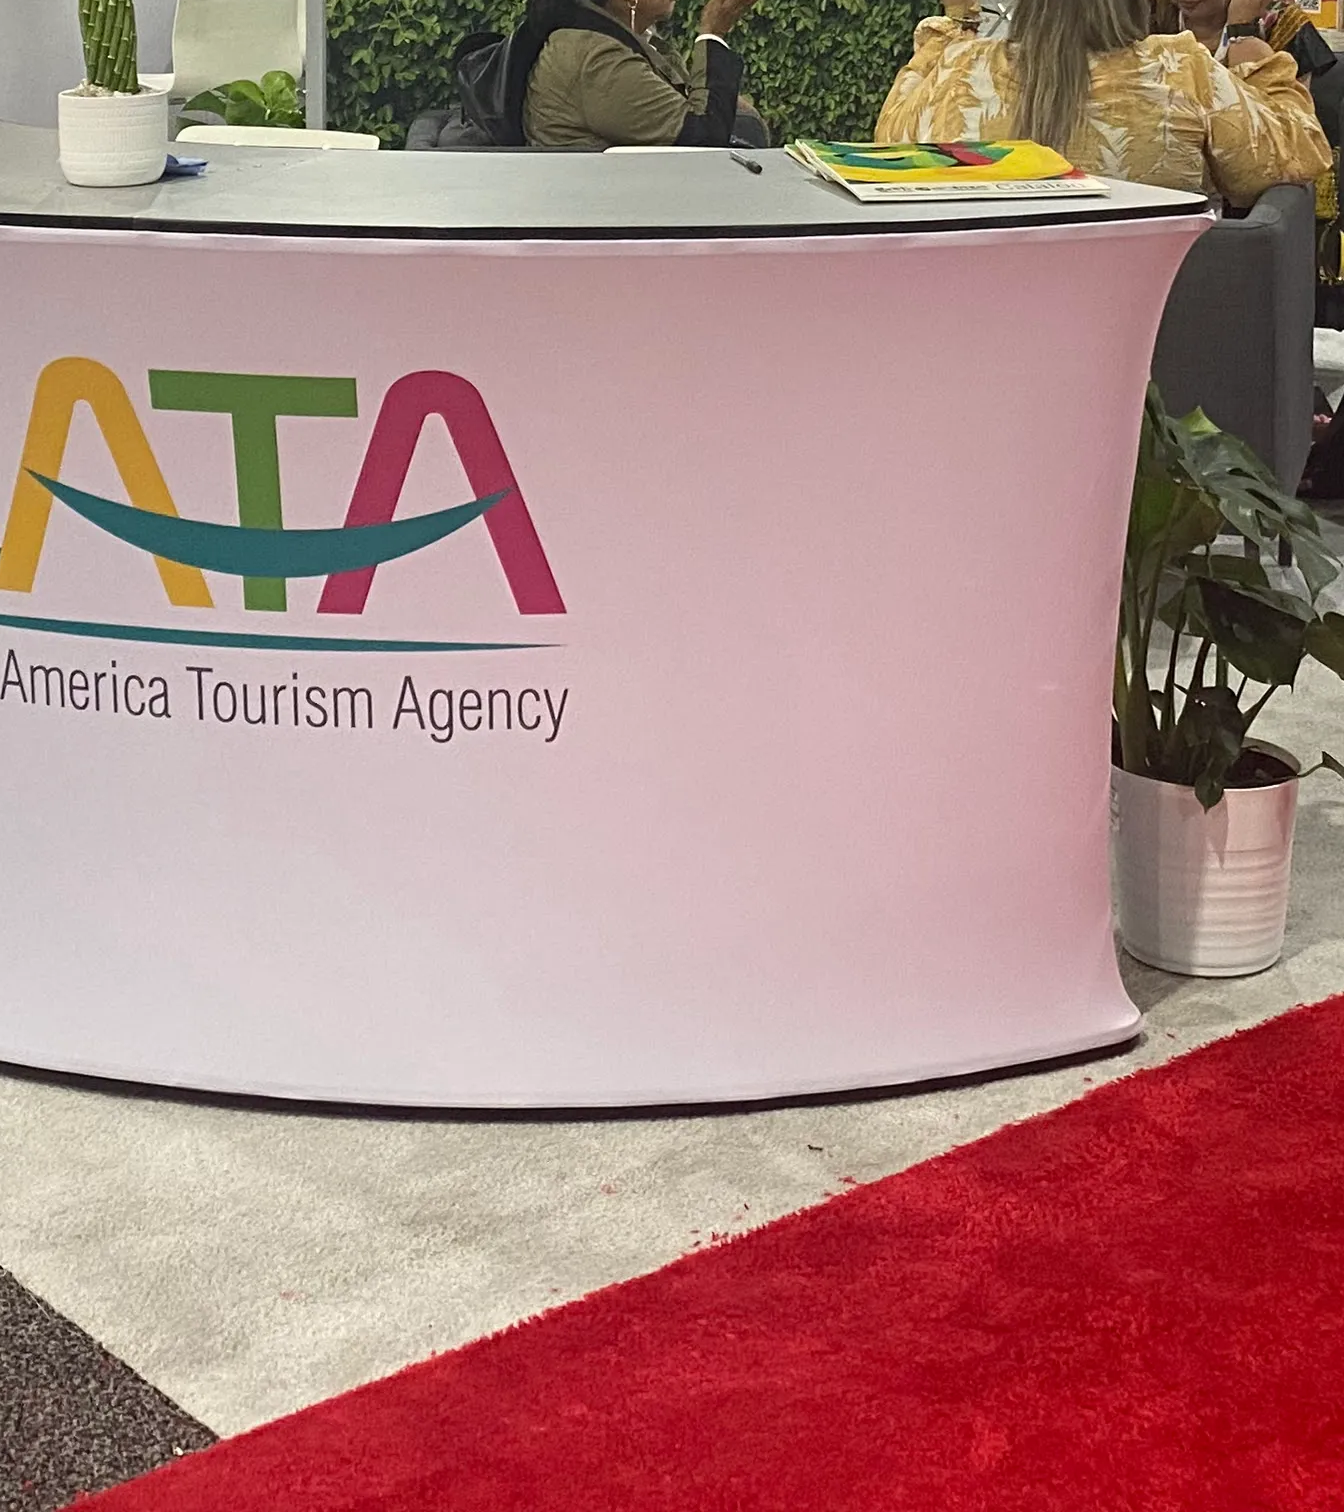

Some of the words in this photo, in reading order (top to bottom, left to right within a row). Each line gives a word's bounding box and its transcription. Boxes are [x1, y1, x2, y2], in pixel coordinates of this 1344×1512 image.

[0, 649, 172, 719] America
[186, 667, 373, 729] Tourism
[392, 675, 568, 743] Agency
